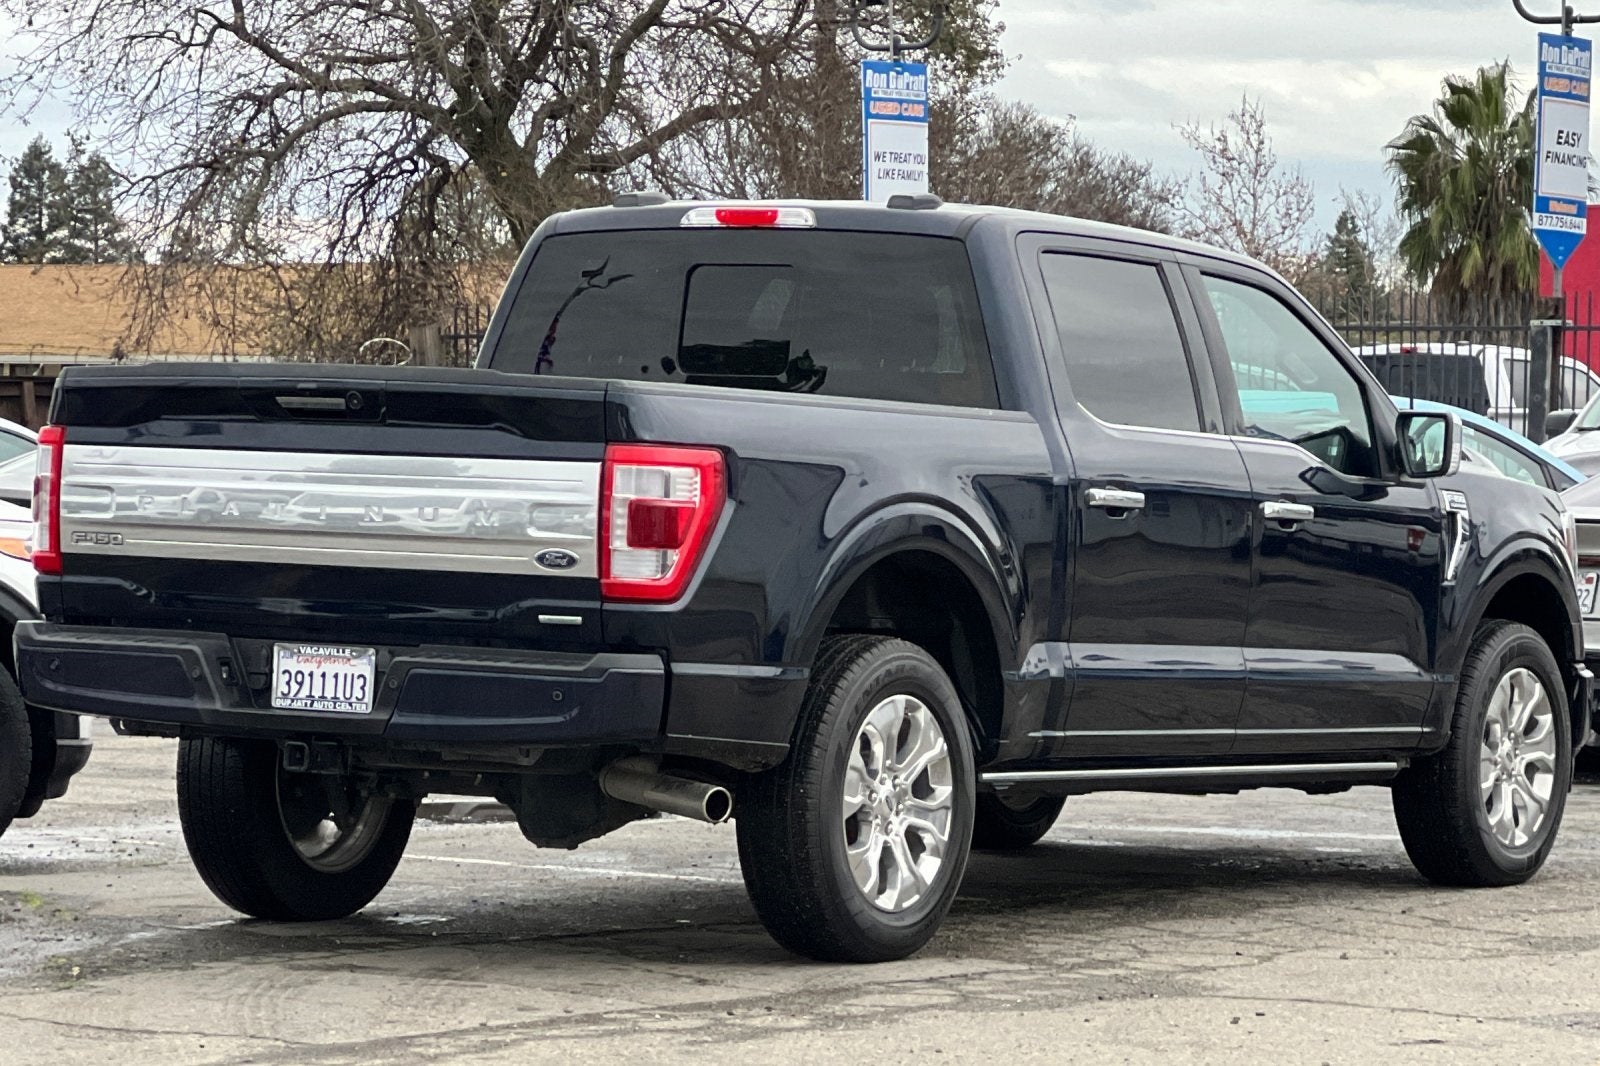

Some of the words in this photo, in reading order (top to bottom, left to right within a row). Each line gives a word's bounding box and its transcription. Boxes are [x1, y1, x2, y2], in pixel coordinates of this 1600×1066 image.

[1542, 42, 1560, 63] Ron
[1561, 45, 1590, 68] DuPratt
[866, 69, 887, 88] Ron
[889, 71, 925, 91] DuPratt
[870, 101, 900, 115] USED
[901, 102, 925, 117] CARS
[1556, 129, 1582, 148] EASY
[873, 151, 887, 162] WE
[889, 152, 911, 164] TREAT
[913, 153, 926, 165] YOU
[1545, 150, 1587, 169] FINANCING
[878, 168, 895, 180] LIKE
[137, 495, 499, 527] PLATINUM
[71, 531, 124, 545] F-150
[299, 646, 351, 656] VACAVILLE
[280, 668, 367, 702] 39111U3
[275, 698, 311, 708] DUPRATT
[313, 701, 334, 709] AUTO
[336, 702, 367, 711] CENTER
